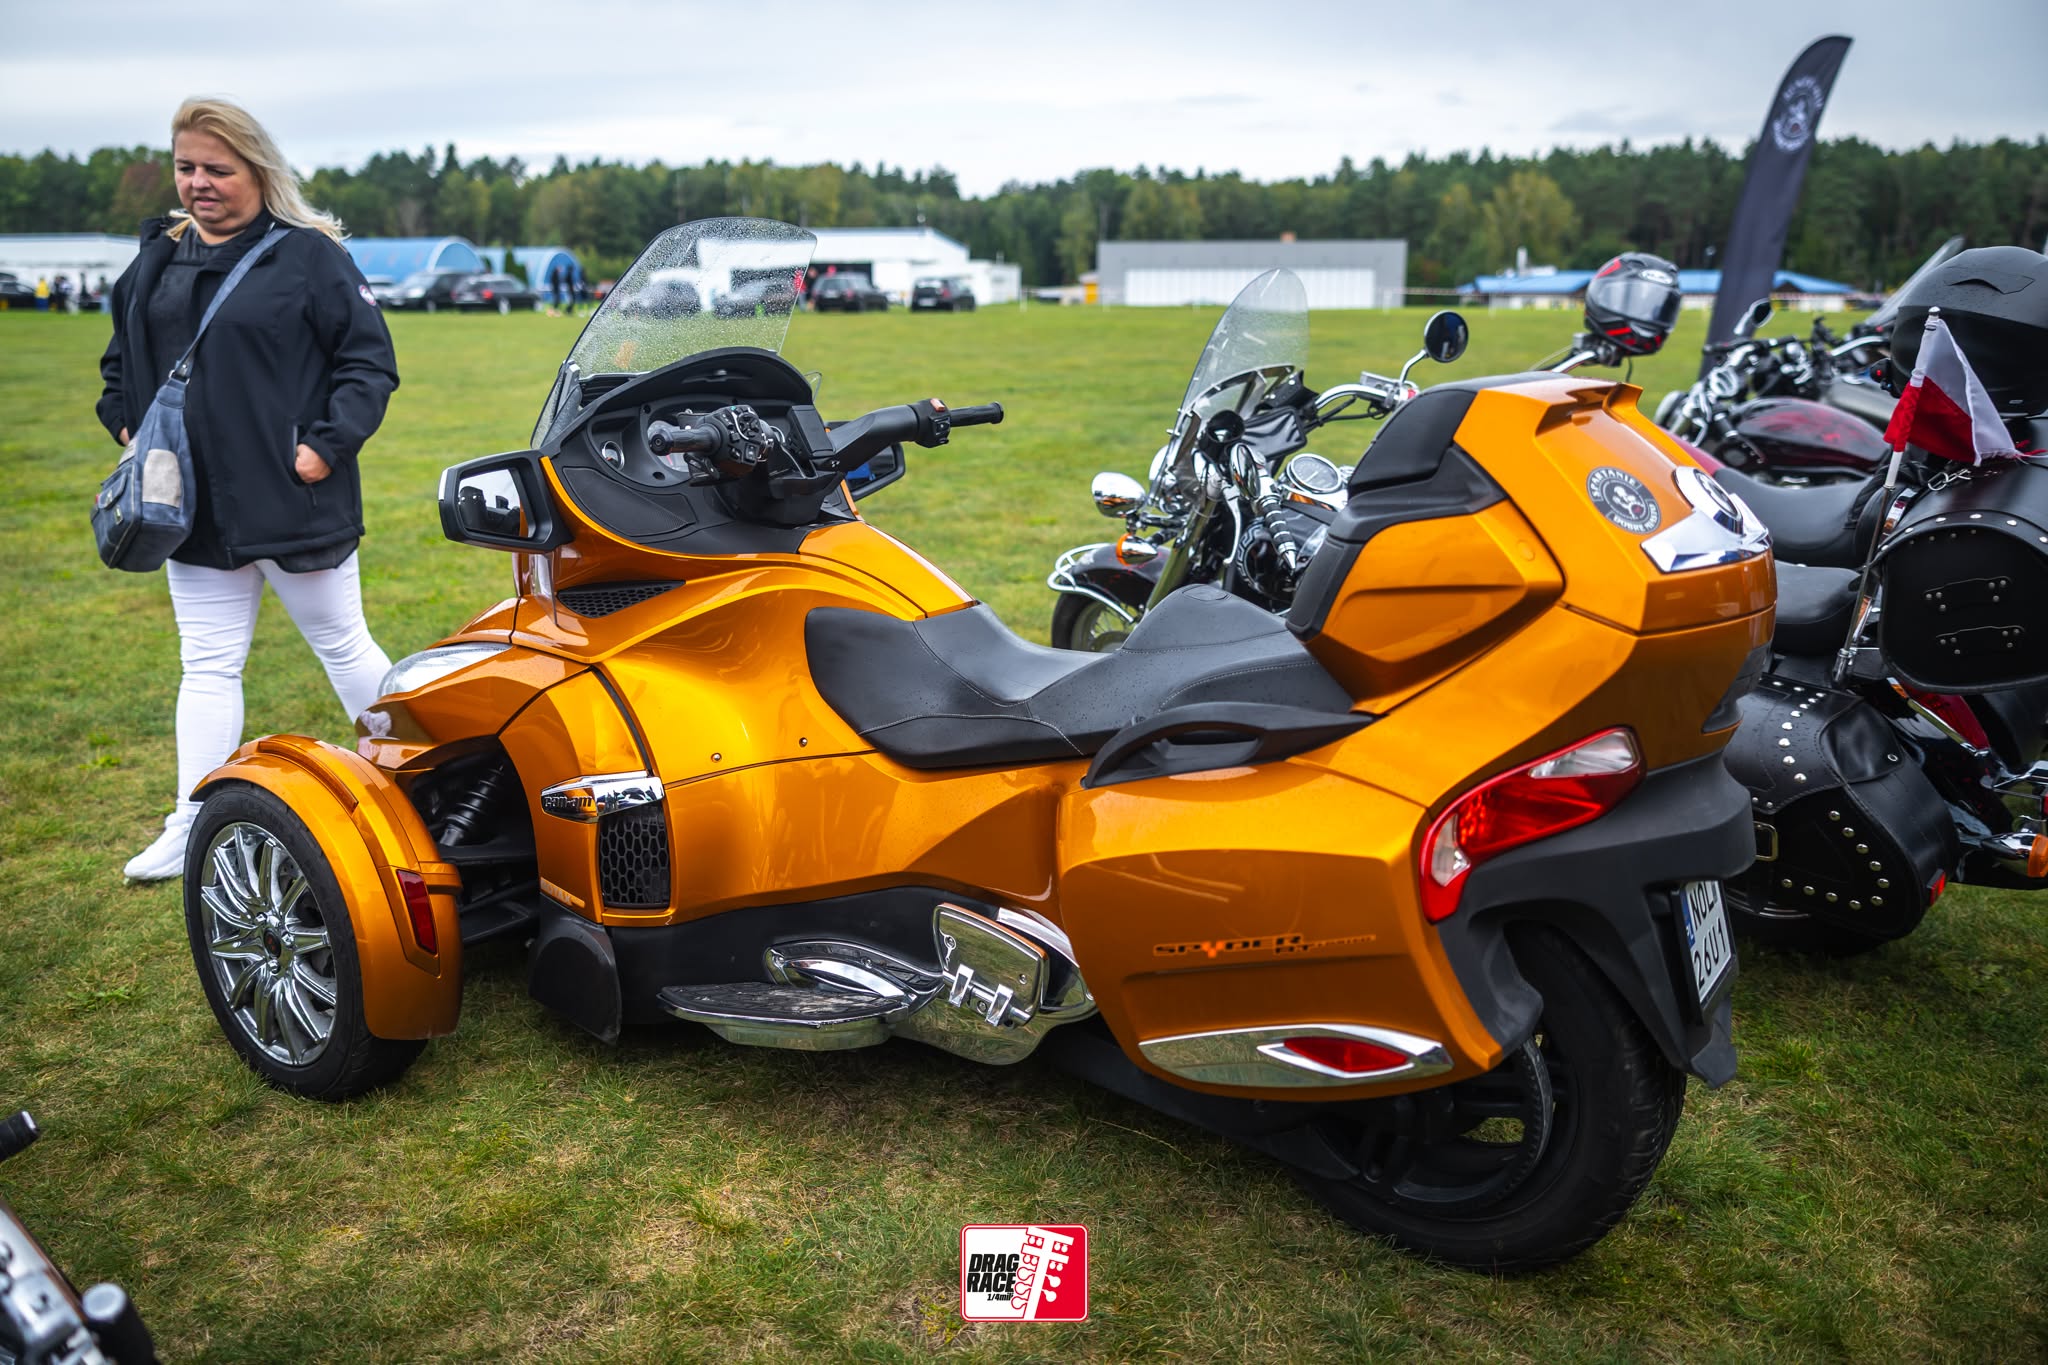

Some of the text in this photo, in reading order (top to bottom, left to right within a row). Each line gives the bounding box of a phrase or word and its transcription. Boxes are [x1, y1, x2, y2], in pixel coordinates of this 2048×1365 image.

[1689, 880, 1715, 931] NOL
[1153, 932, 1304, 958] SPYDER
[1693, 917, 1727, 990] 26U1
